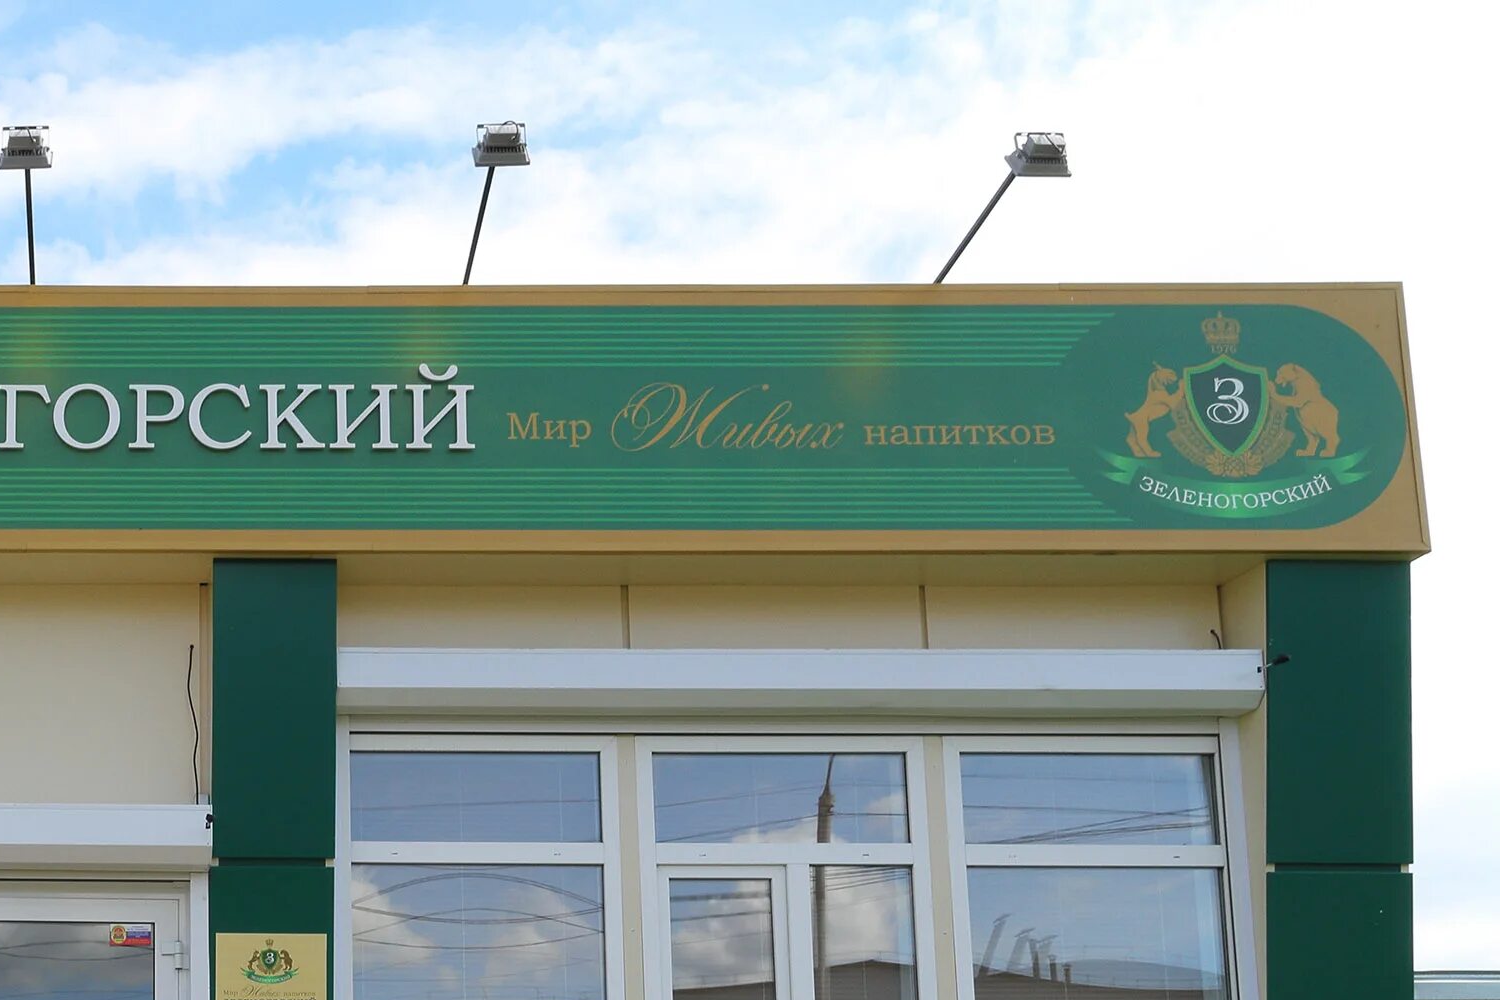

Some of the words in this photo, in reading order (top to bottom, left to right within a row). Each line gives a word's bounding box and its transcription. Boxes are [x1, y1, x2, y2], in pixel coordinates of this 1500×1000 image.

[507, 412, 592, 448] Мир
[611, 381, 844, 452] Живых
[864, 423, 1056, 445] напитков
[1139, 474, 1332, 509] ЗЕЛЕНОГОРСКИЙ
